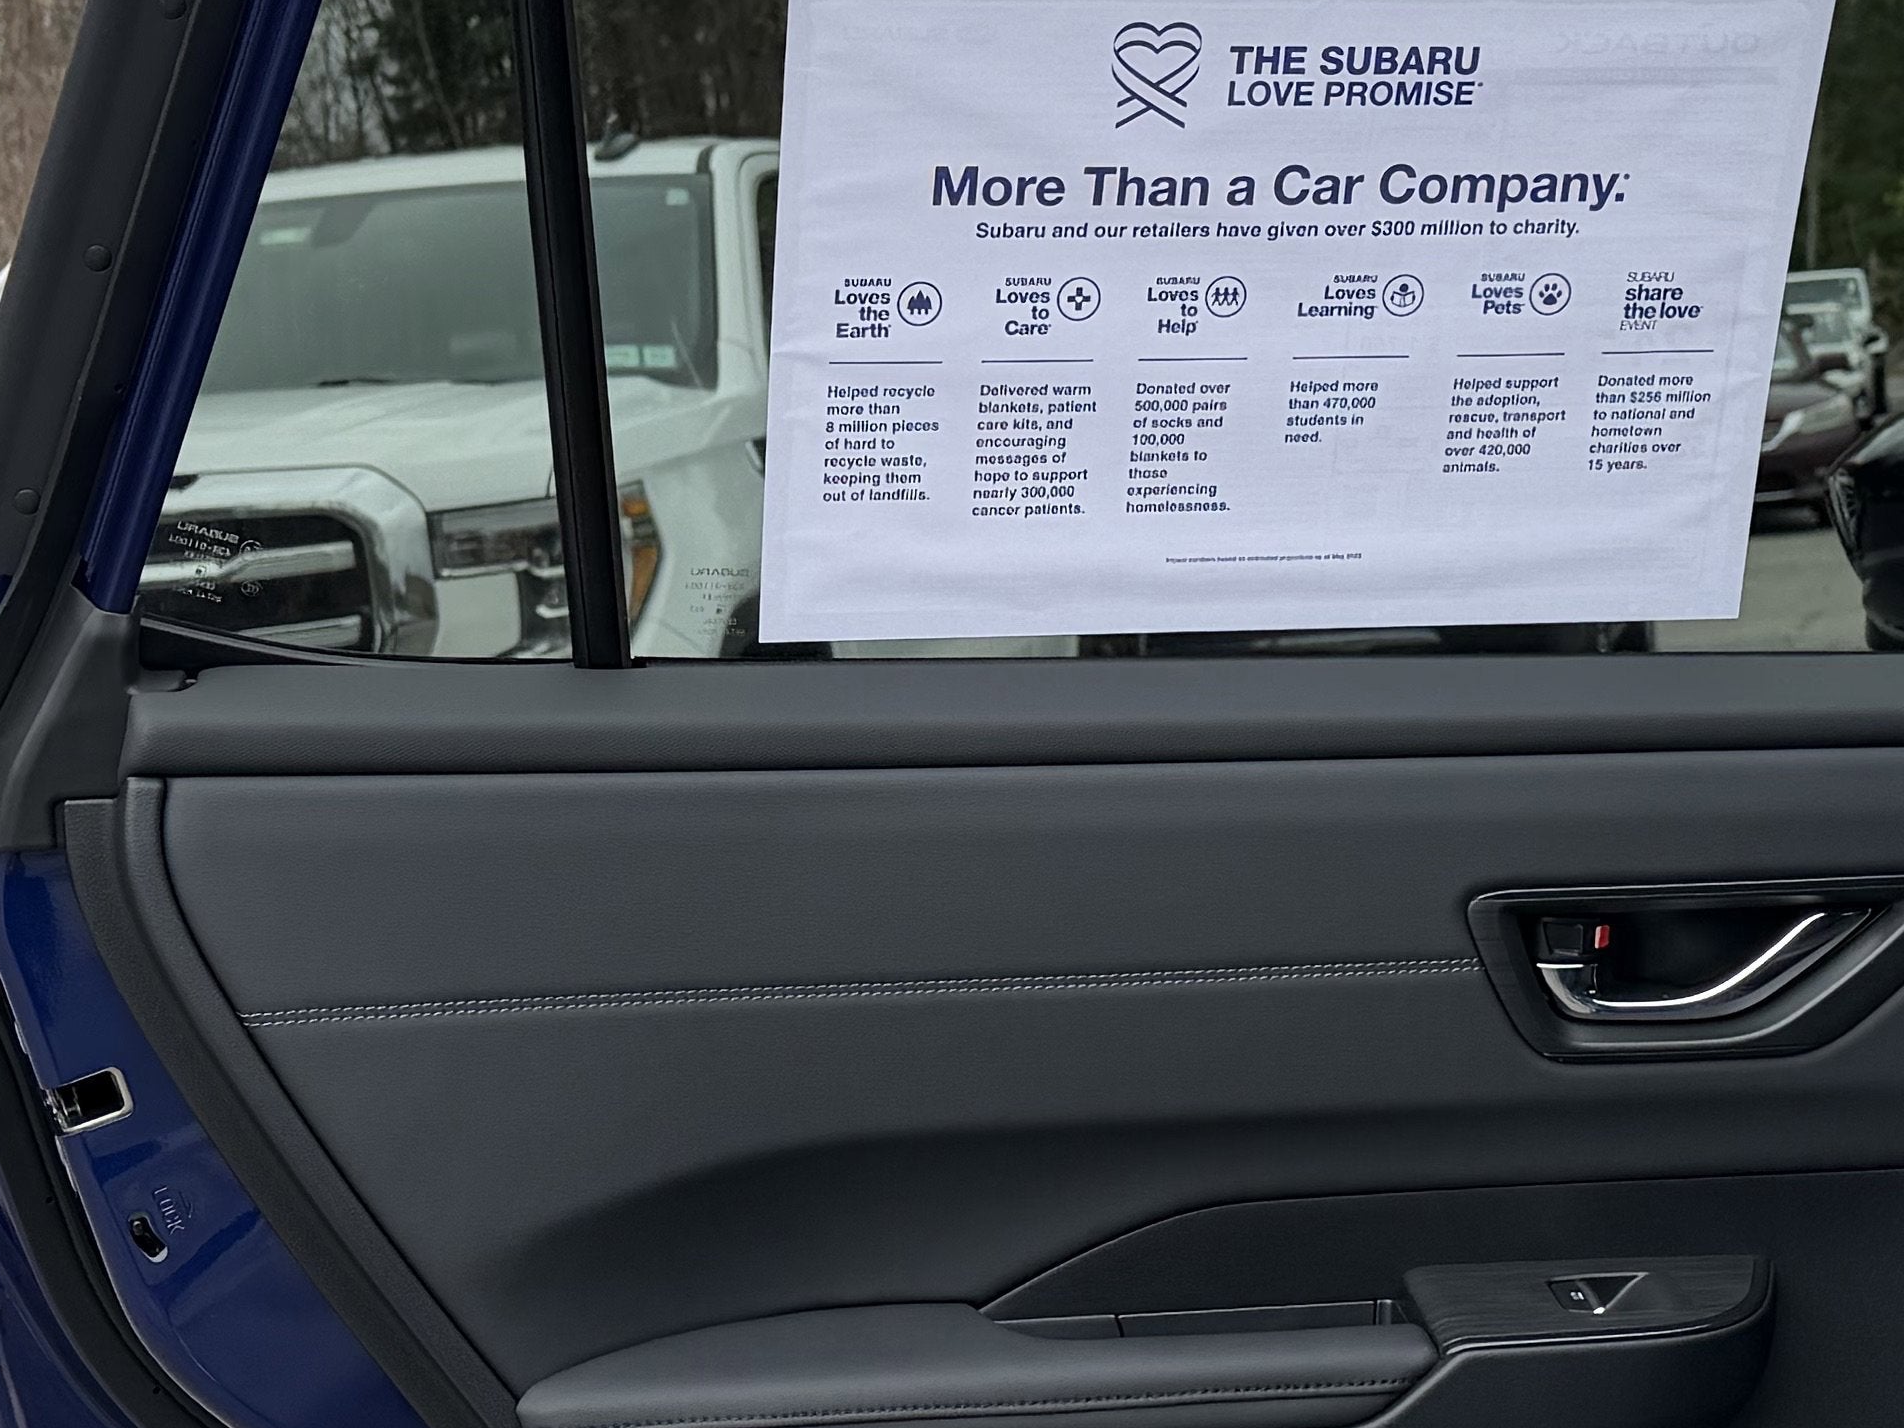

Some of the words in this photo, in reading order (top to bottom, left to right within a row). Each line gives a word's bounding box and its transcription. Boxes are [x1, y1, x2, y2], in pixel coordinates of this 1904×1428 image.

[1230, 46, 1307, 75] THE
[1320, 46, 1480, 75] SUBARU
[1228, 81, 1315, 106] LOVE
[932, 166, 1065, 206] More
[1084, 167, 1209, 206] Than
[1227, 176, 1255, 206] a
[1274, 164, 1365, 206] Car
[976, 222, 1046, 238] Subaru
[1052, 222, 1088, 238] and
[1094, 226, 1126, 238] our
[1133, 222, 1210, 238] retailers
[1217, 222, 1261, 237] have
[1267, 221, 1318, 241] given
[1325, 224, 1366, 236] over
[1371, 220, 1415, 237] $300
[1421, 220, 1483, 235] million
[1490, 220, 1507, 235] to
[1513, 219, 1579, 238] charity.
[1006, 278, 1051, 286] SUBARU
[1627, 272, 1675, 282] SUBARU
[836, 289, 890, 304] Loves
[997, 288, 1050, 303] Loves
[1148, 287, 1199, 301] Loves
[1325, 285, 1376, 300] Loves
[1472, 284, 1523, 299] Loves
[1625, 285, 1684, 301] share
[859, 306, 890, 321] the
[1032, 306, 1049, 320] to
[1181, 304, 1198, 317] to
[1298, 302, 1376, 319] Learning
[1483, 301, 1524, 315] Pets
[1623, 303, 1657, 319] the
[1659, 302, 1703, 319] love
[837, 323, 891, 338] Earth
[1006, 320, 1051, 335] Care
[1158, 319, 1198, 336] Help
[1619, 320, 1657, 331] EVENT
[1135, 381, 1196, 395] Donated
[1199, 383, 1232, 395] over
[1289, 379, 1340, 396] Helped
[1342, 381, 1379, 393] more
[1452, 376, 1502, 392] Helped
[1505, 376, 1560, 393] support
[1597, 373, 1656, 388] Donated
[1658, 375, 1694, 387] more
[827, 384, 879, 402] Helped
[882, 384, 936, 400] recycle
[979, 383, 1049, 397] Delivered
[1052, 385, 1092, 396] warm
[1595, 391, 1626, 404] than
[1629, 390, 1662, 404] $256
[1665, 389, 1712, 403] million
[1047, 399, 1097, 416] patient
[1134, 398, 1189, 413] 500,000
[1191, 398, 1228, 415] pairs
[1288, 397, 1320, 410] than
[1322, 395, 1377, 412] 470,000
[1450, 394, 1474, 407] the
[826, 405, 865, 416] more
[868, 402, 901, 416] than
[1592, 408, 1608, 421] to
[1610, 407, 1667, 421] national
[1668, 407, 1696, 420] and
[976, 420, 1009, 431] care
[1045, 417, 1074, 431] and
[1132, 416, 1148, 429] of
[1151, 416, 1193, 429] socks
[1196, 415, 1224, 429] and
[1285, 413, 1348, 427] students
[1350, 413, 1365, 426] in
[1502, 409, 1567, 425] transport
[825, 420, 835, 434] 8
[838, 419, 888, 433] million
[891, 419, 940, 436] pieces
[1445, 427, 1473, 441] and
[1476, 426, 1519, 440] health
[1522, 425, 1537, 439] of
[1590, 424, 1663, 438] hometown
[824, 437, 840, 451] of
[843, 437, 877, 451] hard
[880, 437, 896, 450] to
[975, 434, 1067, 451] encouraging
[1131, 432, 1185, 448] 100,000
[1588, 441, 1648, 454] charities
[1651, 442, 1682, 453] over
[1129, 449, 1190, 463] blankets
[1193, 450, 1208, 462] to
[1444, 446, 1476, 457] over
[1478, 442, 1532, 458] 420,000
[823, 454, 877, 471] recycle
[975, 454, 1048, 468] messages
[1051, 451, 1067, 464] of
[1588, 458, 1604, 471] 15
[823, 471, 881, 488] keeping
[885, 471, 922, 485] them
[974, 469, 1011, 486] hope
[1014, 469, 1029, 482] to
[1031, 468, 1089, 484] support
[1128, 466, 1168, 480] those
[822, 489, 847, 503] out
[850, 488, 866, 502] of
[972, 486, 1018, 502] nearly
[1020, 484, 1076, 500] 300,000
[1126, 482, 1218, 500] experiencing
[971, 505, 1022, 518] cancer
[153, 1184, 186, 1236] LOCK
